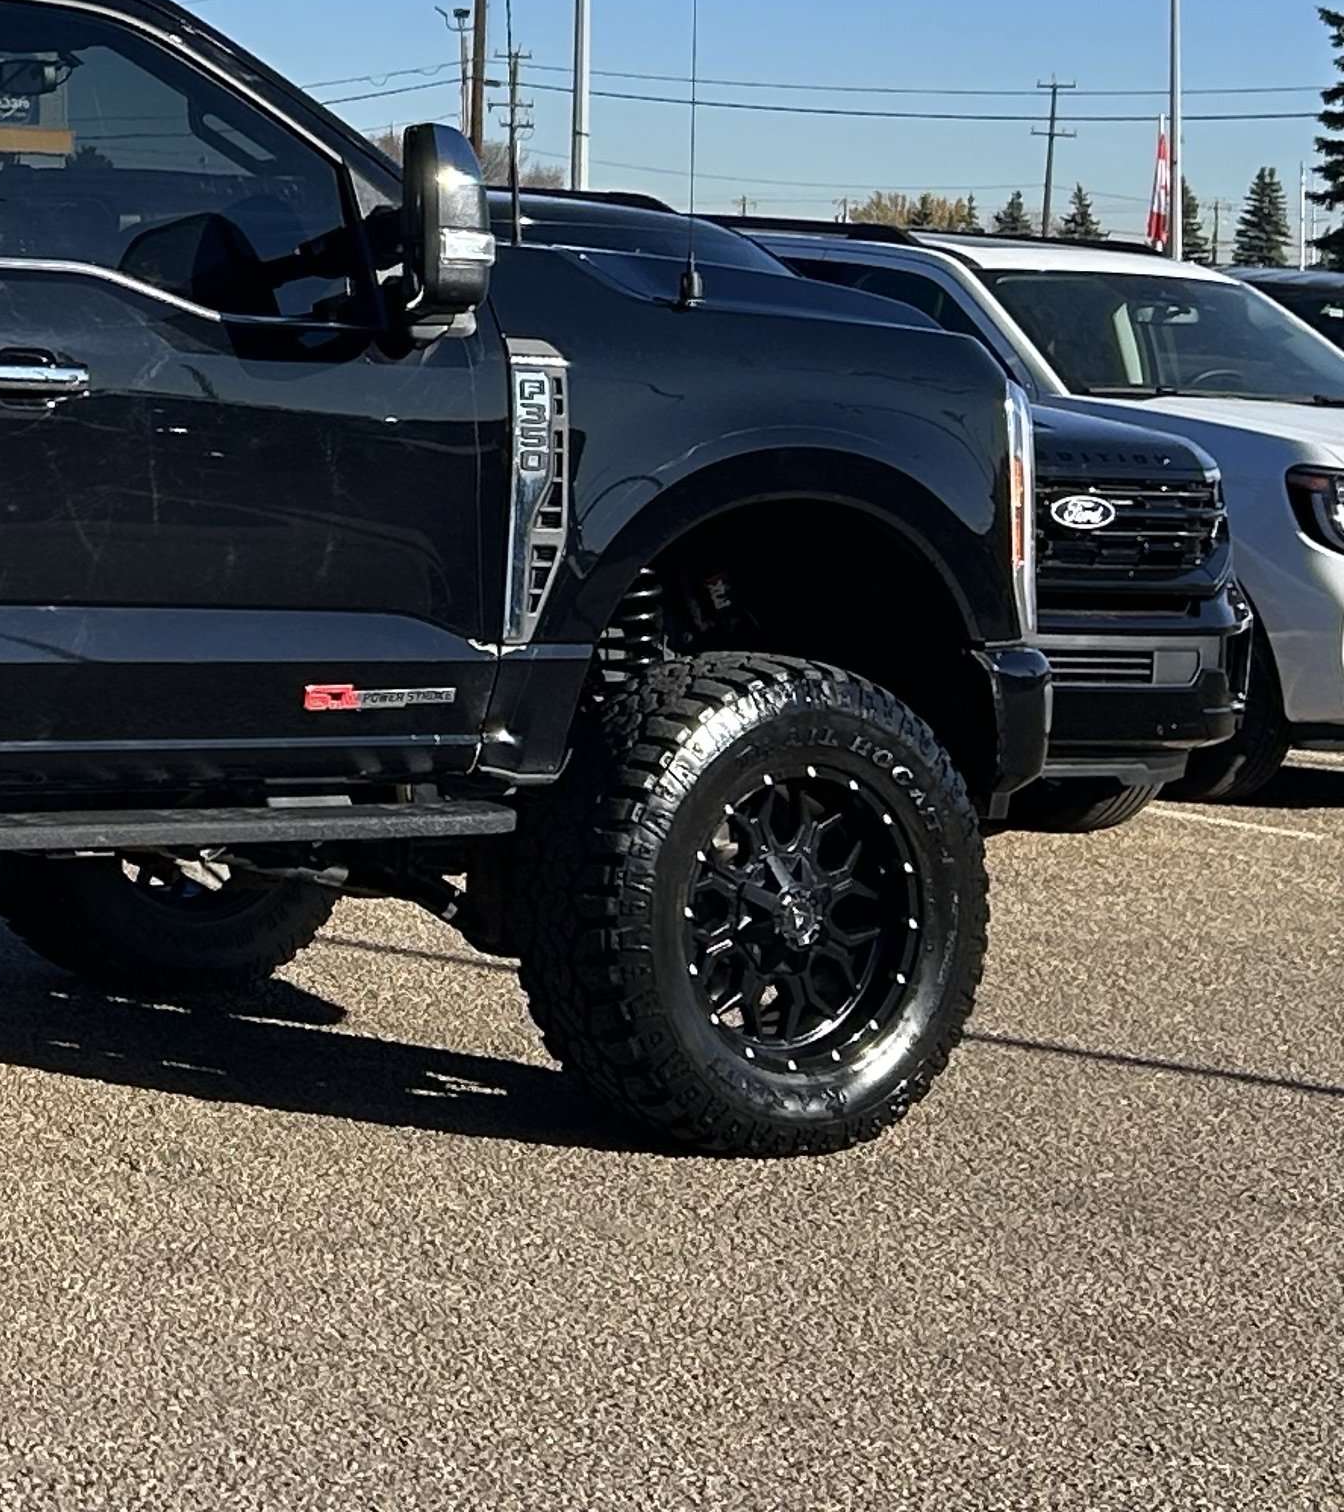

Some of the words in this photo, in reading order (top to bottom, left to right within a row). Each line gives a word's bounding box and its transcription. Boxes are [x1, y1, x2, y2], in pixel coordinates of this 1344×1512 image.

[518, 378, 548, 473] F350
[362, 691, 405, 704] POWER
[848, 735, 914, 786] HOG
